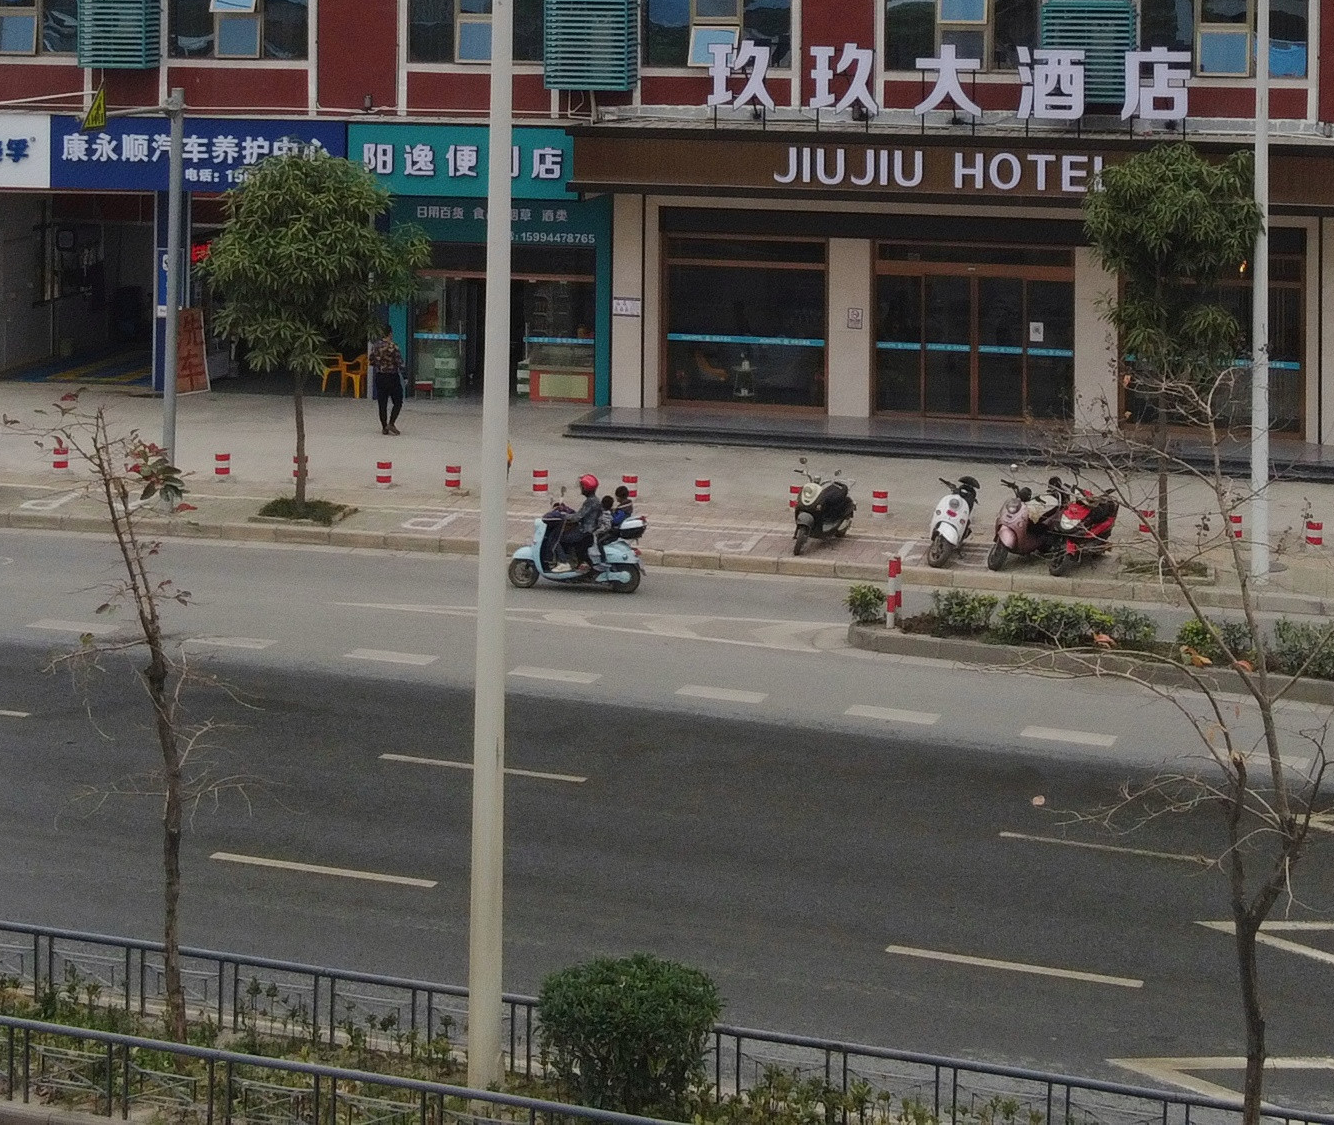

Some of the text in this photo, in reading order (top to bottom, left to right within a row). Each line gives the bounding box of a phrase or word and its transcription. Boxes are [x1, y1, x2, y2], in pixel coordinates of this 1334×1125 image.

[706, 39, 1193, 121] 玖玖大酒店
[362, 142, 564, 179] 阳逸便店
[772, 145, 924, 187] JIUJIU
[416, 205, 464, 220] 日用百货
